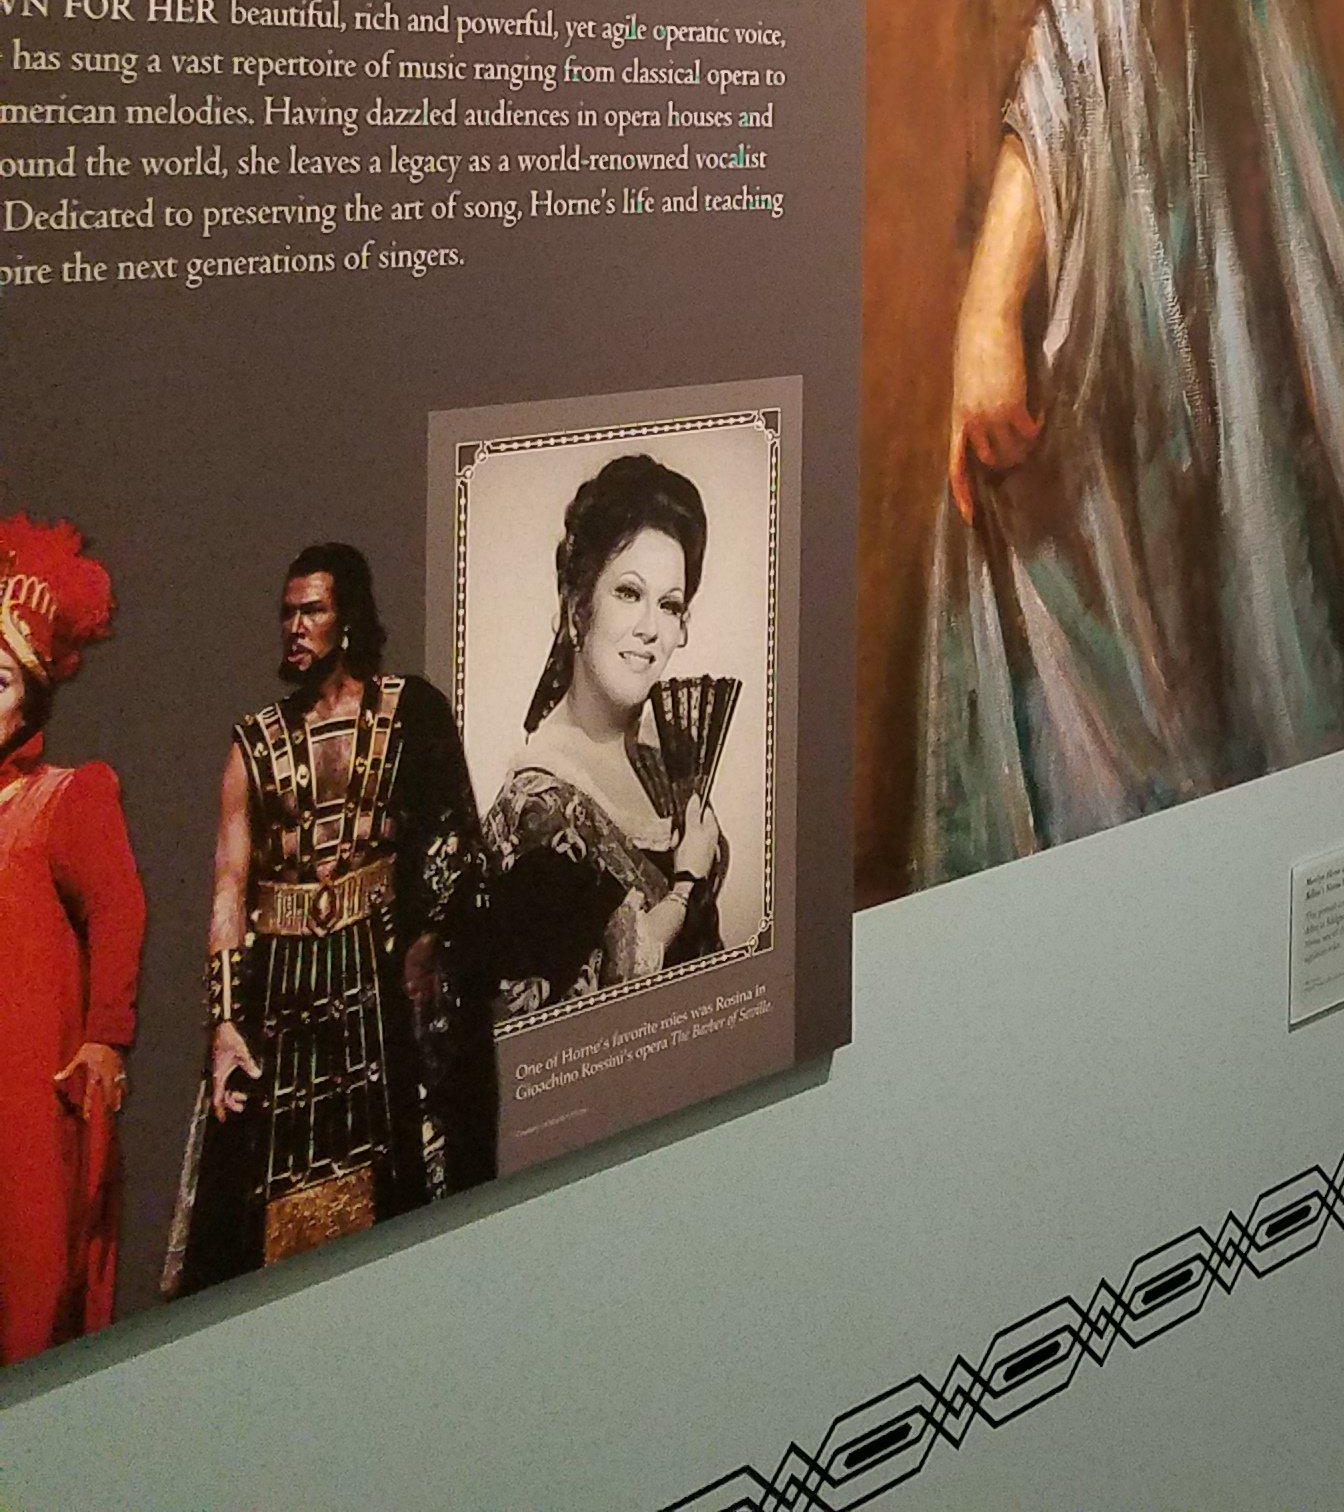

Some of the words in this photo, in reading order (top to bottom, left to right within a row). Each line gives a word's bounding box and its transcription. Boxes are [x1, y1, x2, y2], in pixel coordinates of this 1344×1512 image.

[354, 2, 401, 32] rich
[407, 5, 449, 33] and
[456, 9, 559, 43] powerful,
[564, 19, 598, 47] yet
[601, 13, 647, 48] agile
[652, 19, 730, 51] operatic
[735, 20, 786, 48] voice,
[12, 38, 61, 70] has
[71, 51, 139, 84] sung
[147, 53, 162, 73] a
[171, 53, 224, 74] vast
[232, 50, 357, 86] repertoire
[364, 50, 395, 79] of
[399, 53, 467, 80] music
[473, 54, 557, 92] ranging
[563, 55, 616, 84] from
[621, 57, 701, 85] classical
[706, 65, 760, 94] opera
[765, 68, 786, 87] to
[0, 94, 118, 125] merican
[126, 94, 255, 126] melodies.
[264, 96, 359, 136] Having
[366, 97, 457, 128] dazzled
[464, 98, 570, 128] audiences
[577, 101, 598, 127] in
[604, 109, 662, 137] opera
[667, 101, 733, 129] houses
[738, 102, 774, 128] and
[0, 146, 77, 178] ound
[86, 146, 132, 178] the
[142, 144, 229, 180] world,
[237, 144, 281, 176] she
[289, 144, 361, 175] leaves
[369, 154, 383, 175] a
[389, 144, 463, 184] legacy
[468, 151, 492, 173] as
[498, 152, 511, 173] a
[517, 143, 690, 173] world-renowned
[695, 144, 767, 170] vocalist
[3, 196, 155, 232] Dedicated
[164, 205, 193, 229] to
[202, 195, 337, 238] preserving
[344, 192, 384, 223] the
[390, 199, 424, 222] art
[431, 190, 462, 221] of
[463, 199, 524, 229] song,
[529, 188, 616, 218] Horne's
[622, 186, 656, 215] life
[661, 185, 699, 214] and
[704, 184, 785, 219] teaching
[61, 251, 109, 284] the
[117, 257, 178, 282] next
[186, 244, 337, 290] generations
[344, 239, 376, 272] of
[379, 240, 466, 279] singers.
[515, 1061, 543, 1081] One
[545, 1052, 560, 1071] of
[611, 1021, 659, 1049] favorite
[660, 1011, 689, 1031] roles
[690, 1002, 715, 1021] was
[715, 989, 754, 1012] Rosina
[754, 983, 767, 998] in
[515, 1069, 580, 1101] Gioachino
[634, 1037, 669, 1063] opera
[670, 1028, 692, 1047] The
